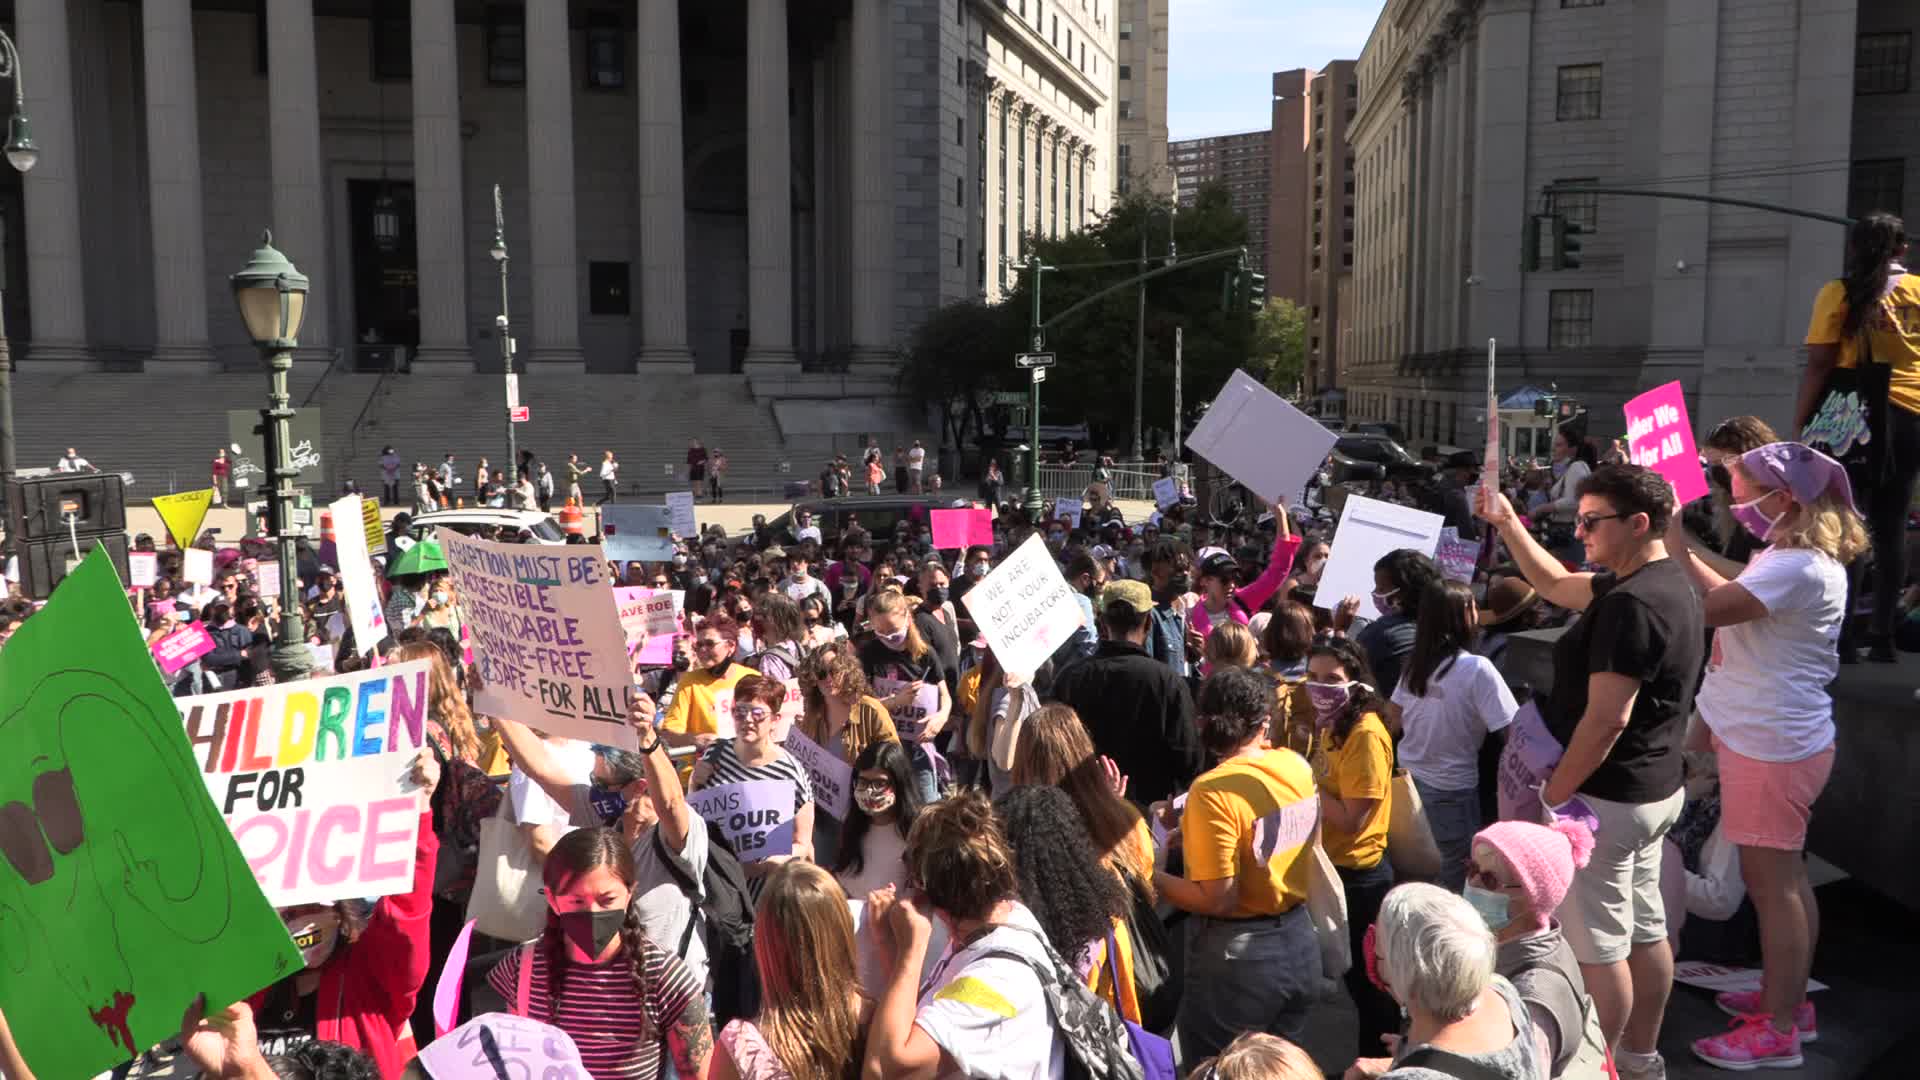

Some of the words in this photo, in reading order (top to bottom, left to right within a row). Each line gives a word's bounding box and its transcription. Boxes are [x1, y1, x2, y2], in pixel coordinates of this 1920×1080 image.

[1654, 405, 1679, 427] We
[1662, 432, 1684, 459] All
[449, 540, 513, 578] ABORTION
[515, 556, 561, 581] MUST
[568, 556, 603, 585] BE:
[985, 582, 1004, 602] WE
[1008, 559, 1031, 583] ARE
[621, 606, 643, 619] AVE
[647, 600, 671, 613] ROE
[992, 601, 1013, 625] NOT
[1018, 575, 1049, 601] YOUR
[1001, 585, 1068, 648] INCUBATORS
[473, 600, 584, 646] AFFORDABLE
[485, 631, 594, 680] SHAME-FREE
[181, 671, 426, 773] HILDREN
[223, 767, 305, 814] FOR
[592, 799, 613, 815] TE
[729, 809, 781, 831] OUR
[227, 796, 416, 890] OICE
